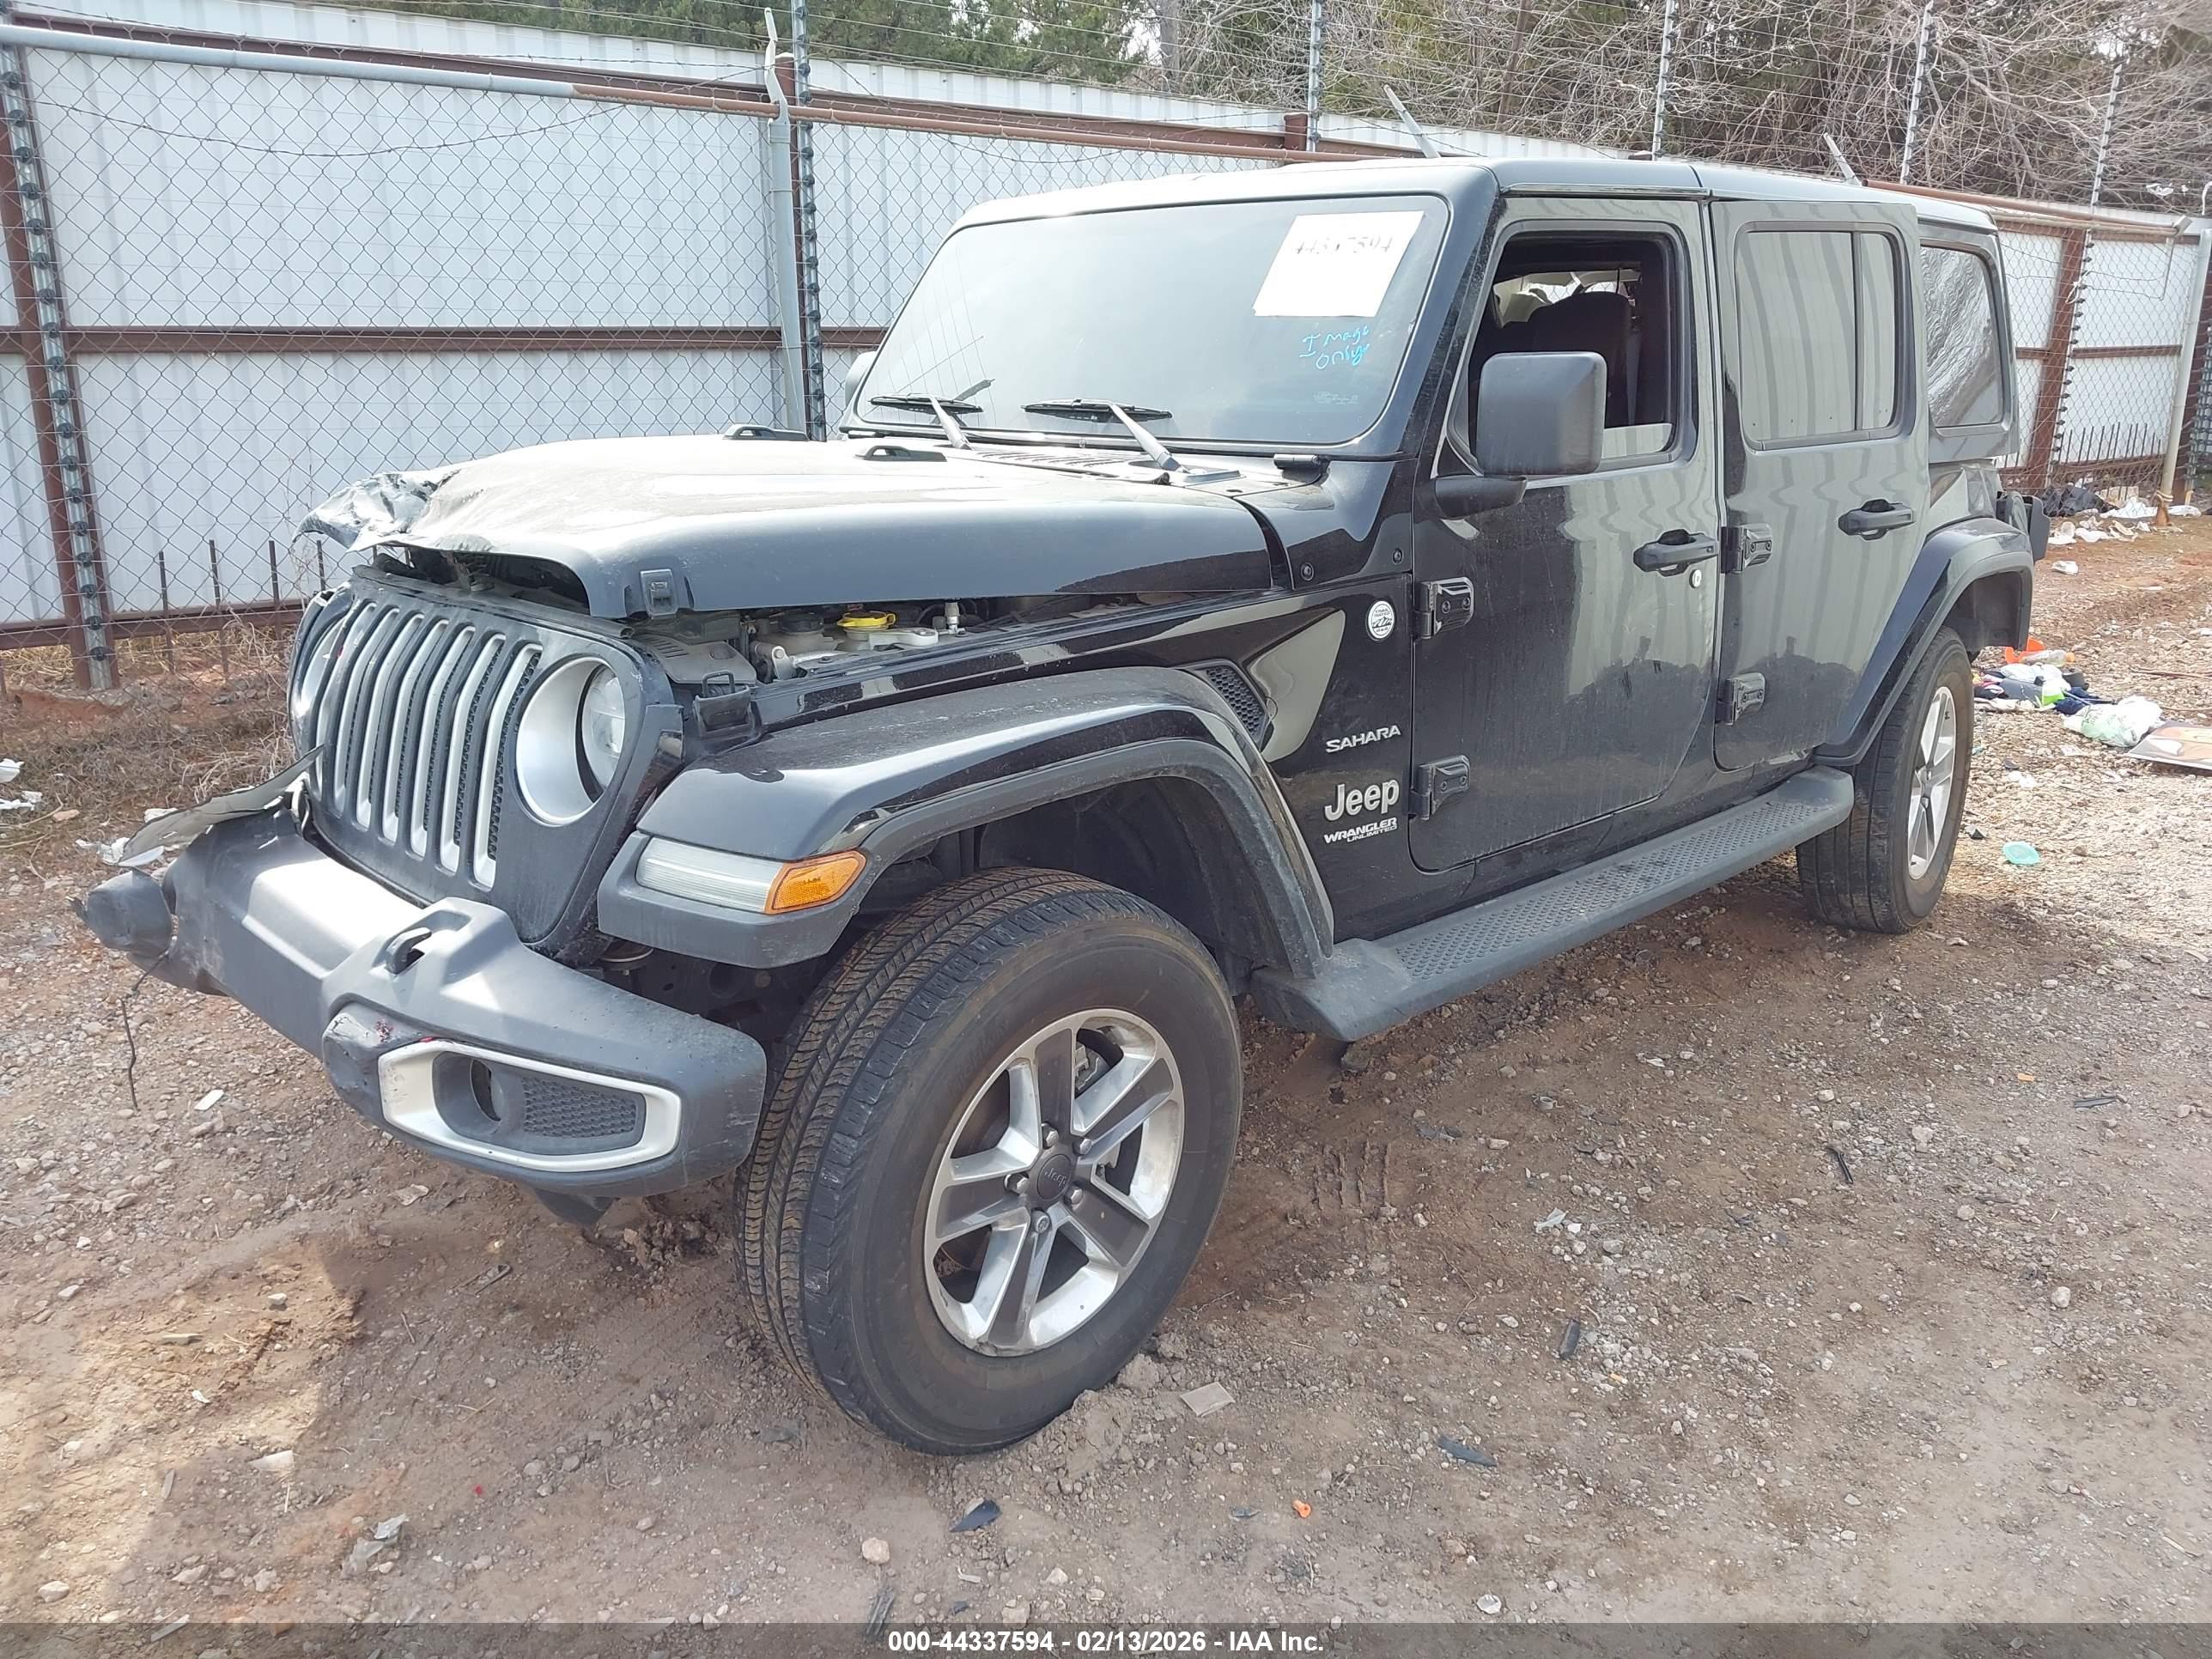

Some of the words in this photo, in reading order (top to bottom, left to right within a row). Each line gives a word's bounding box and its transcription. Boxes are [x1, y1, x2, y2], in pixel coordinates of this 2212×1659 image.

[1326, 725, 1401, 753] SAHARA
[1324, 779, 1400, 821] Jeep
[1323, 817, 1397, 844] WRANGLER
[1346, 824, 1398, 842] UNLIMITED
[1044, 1167, 1067, 1187] Jeep
